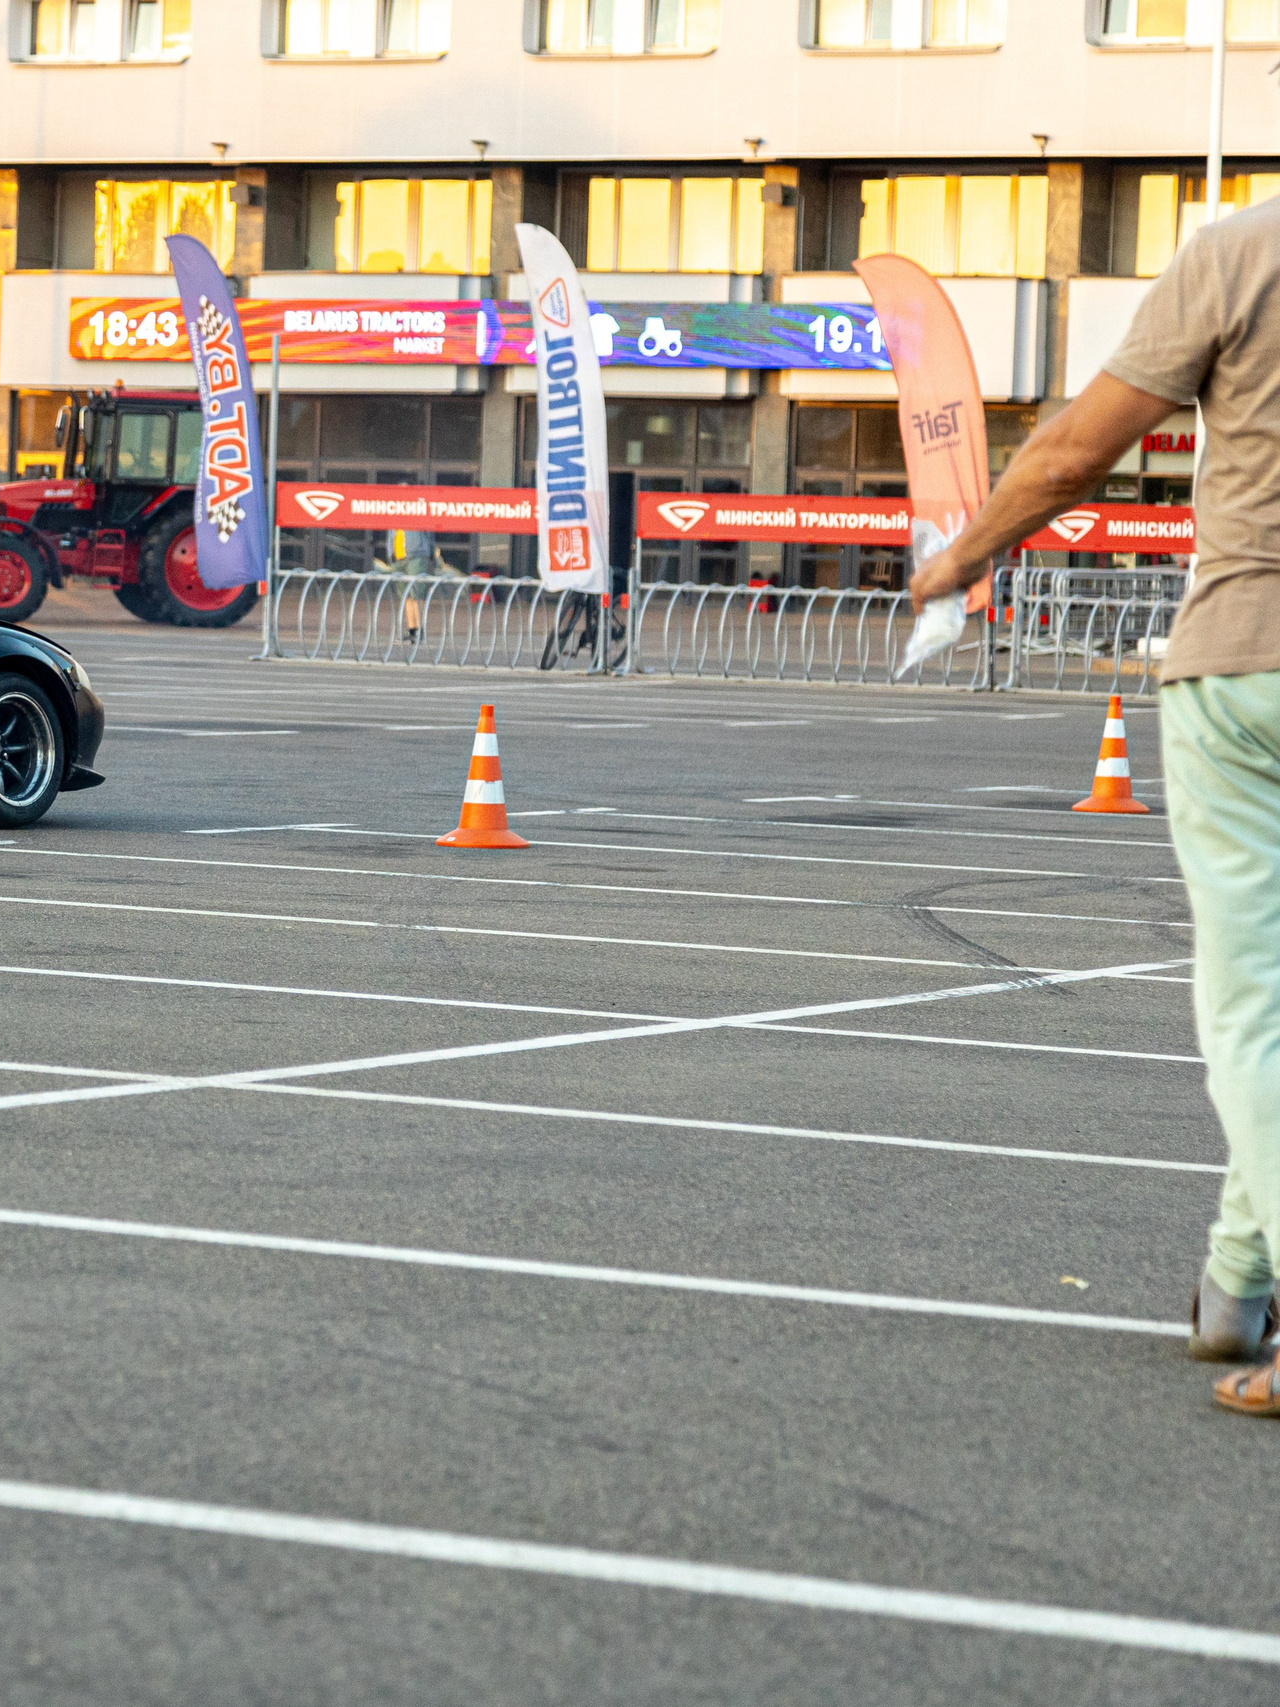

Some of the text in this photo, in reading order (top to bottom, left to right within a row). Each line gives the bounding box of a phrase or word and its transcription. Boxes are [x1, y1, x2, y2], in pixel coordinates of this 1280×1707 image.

[89, 311, 178, 347] 18:43
[284, 311, 445, 333] BELARUS TRACTORS
[393, 337, 445, 354] MARKET
[351, 497, 429, 516] МИНСКИЙ
[429, 501, 531, 519] ТРАКТОРНЫЙ
[716, 508, 908, 530] МИНСКИЙ ТРАКТОРНЫЙ
[1107, 519, 1194, 538] МИНСКИЙ
